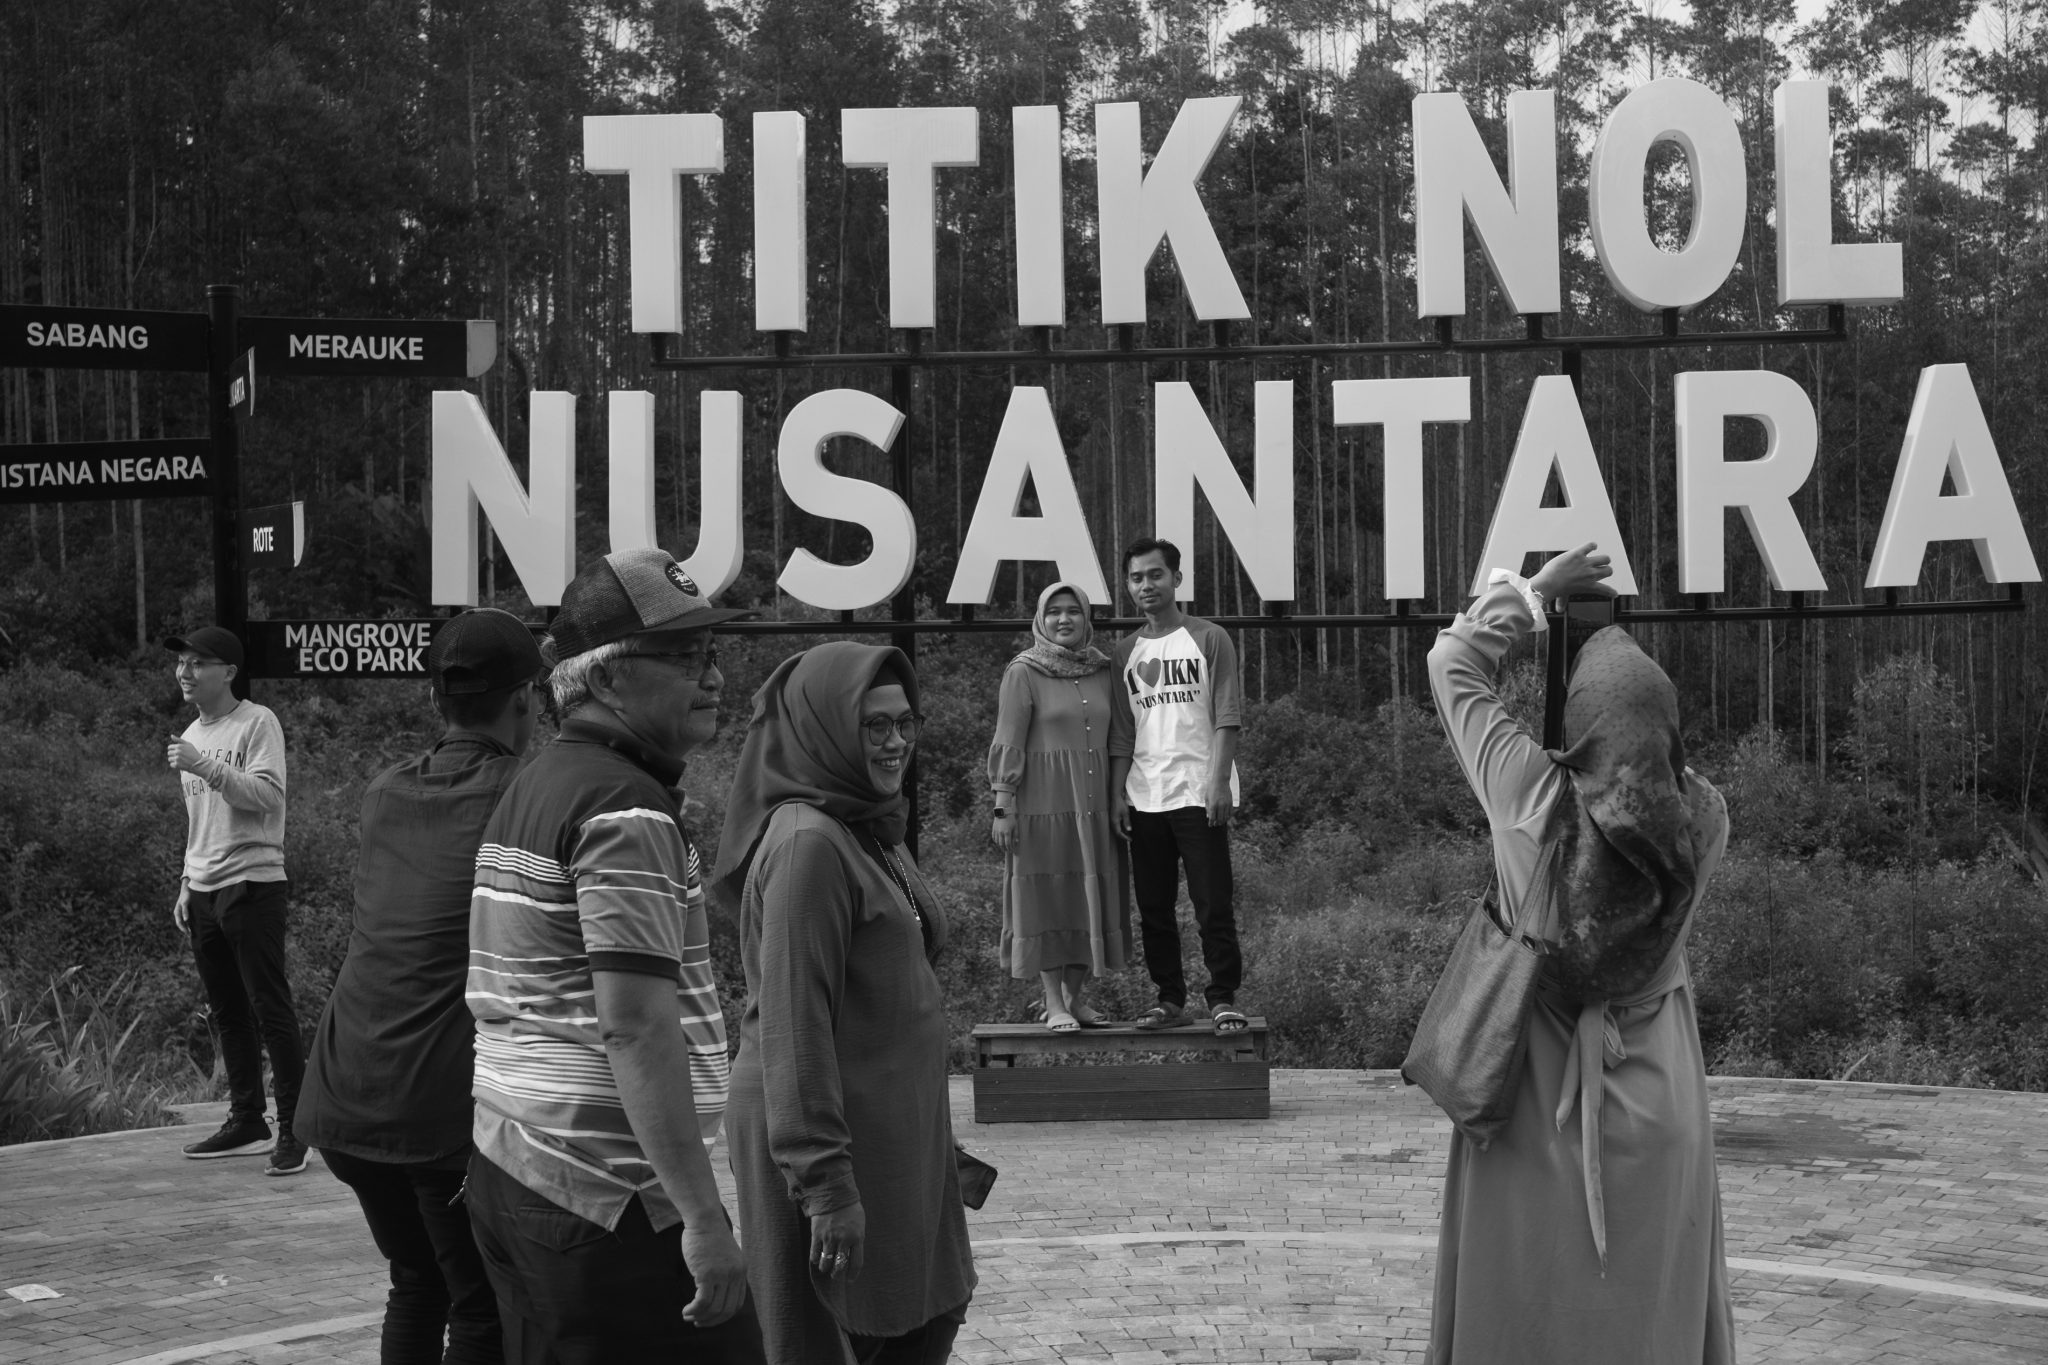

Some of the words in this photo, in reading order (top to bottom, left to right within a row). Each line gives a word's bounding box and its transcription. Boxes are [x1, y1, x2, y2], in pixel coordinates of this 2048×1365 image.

[583, 96, 1251, 333] TITIK
[1412, 77, 1903, 319] NOL
[27, 322, 148, 349] SABANG
[289, 334, 424, 360] MERAUKE
[1, 460, 94, 488] ISTANA
[101, 455, 207, 483] NEGARA
[431, 363, 2041, 609] NUSANTARA
[253, 526, 274, 552] ROTE
[285, 623, 431, 648] MANGROVE
[300, 648, 349, 672] ECO
[356, 648, 425, 672] PARK
[1127, 668, 1140, 695] I
[1163, 658, 1200, 686] IKN
